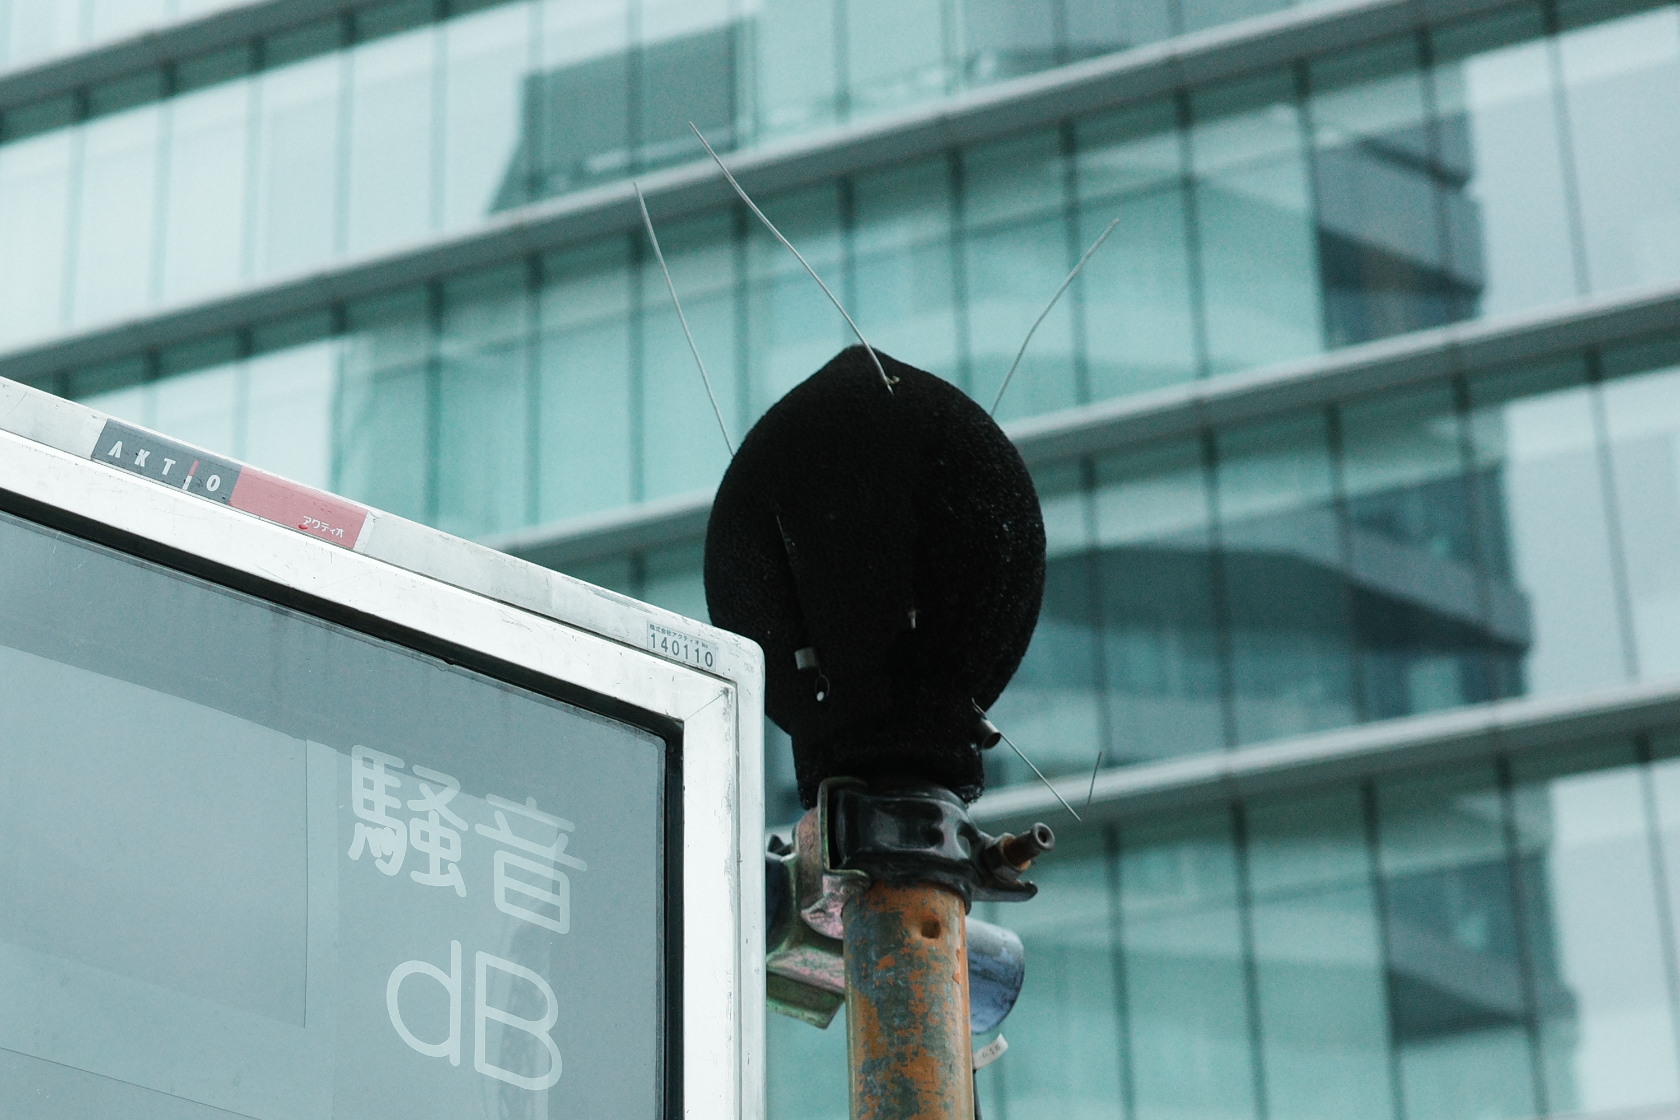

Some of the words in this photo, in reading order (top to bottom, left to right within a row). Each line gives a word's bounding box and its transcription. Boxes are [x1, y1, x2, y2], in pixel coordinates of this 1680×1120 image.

[107, 440, 221, 492] AKTIO
[303, 515, 344, 538] アクティオ
[651, 633, 713, 667] 140110
[347, 744, 588, 935] 騒音
[386, 939, 563, 1091] dB
